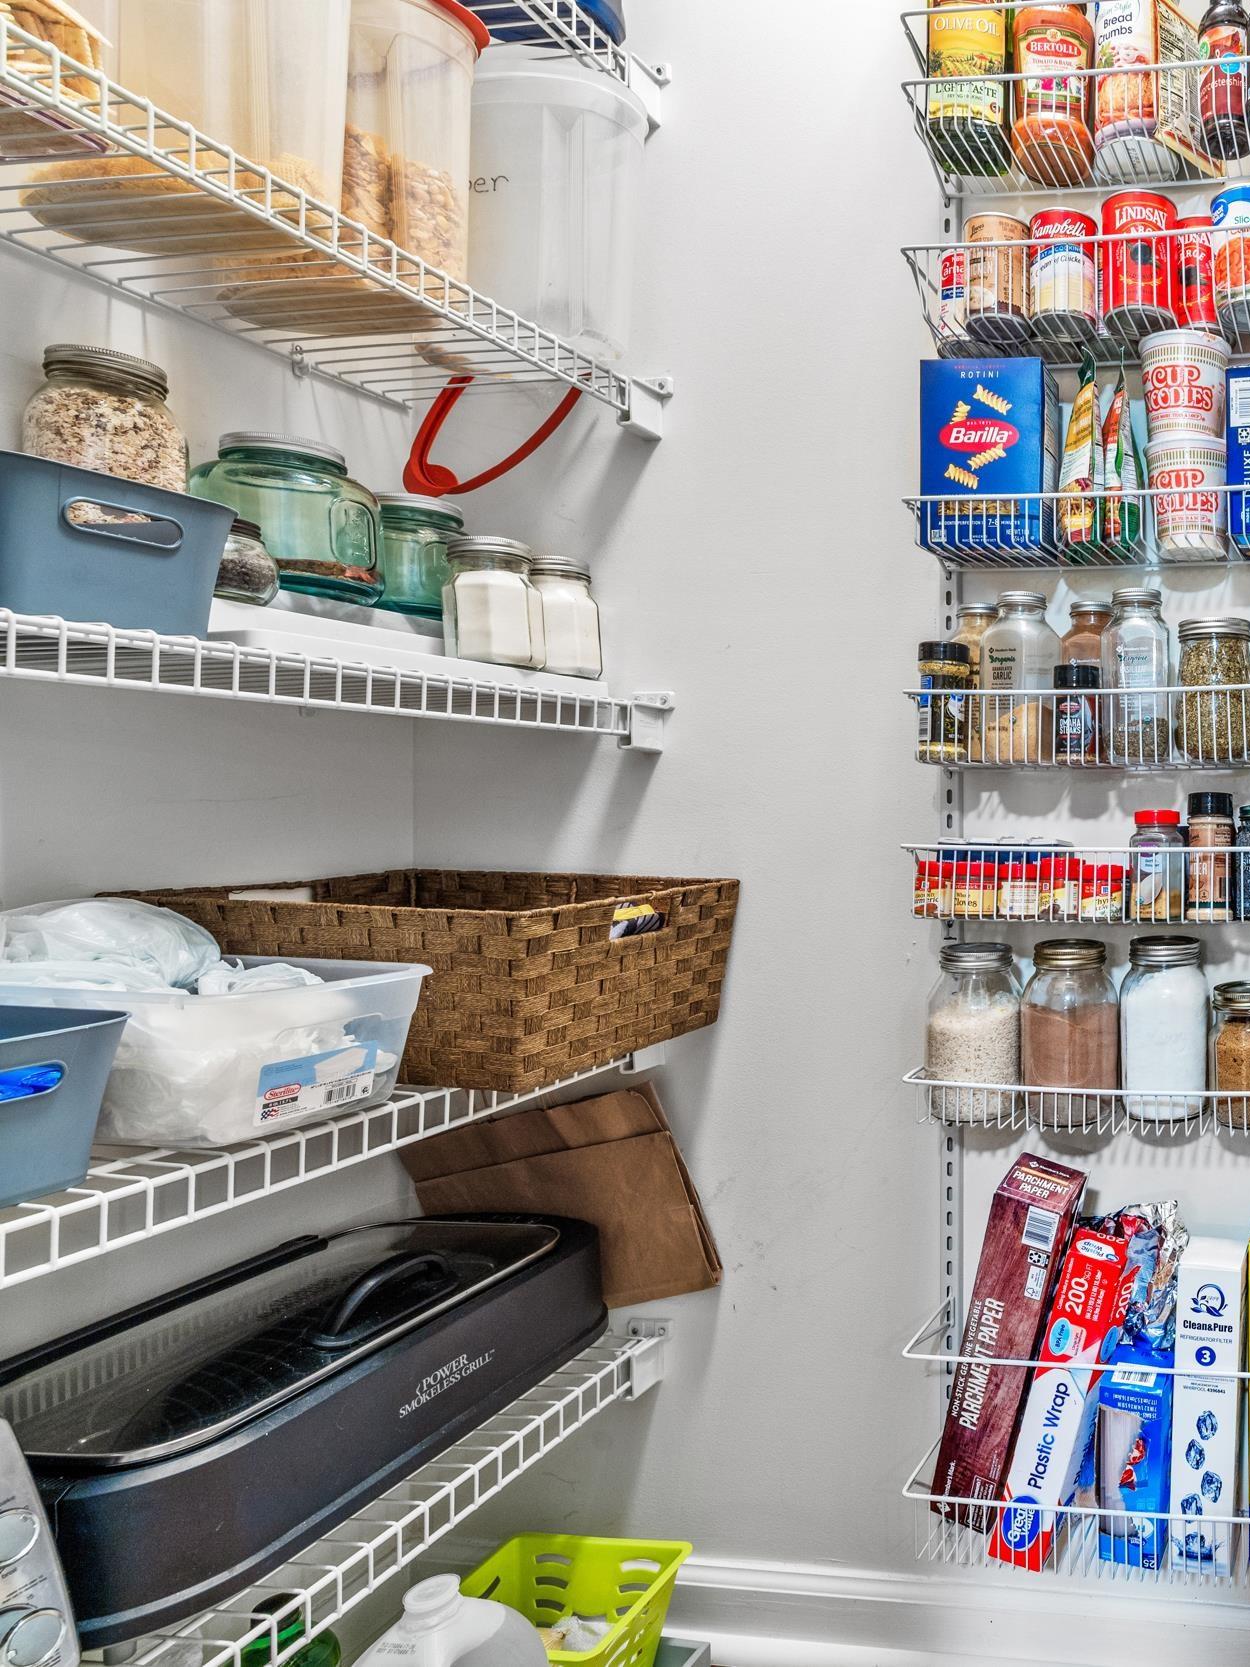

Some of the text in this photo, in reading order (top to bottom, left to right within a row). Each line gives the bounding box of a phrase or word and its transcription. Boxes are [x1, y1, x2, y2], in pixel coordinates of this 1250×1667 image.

[934, 16, 1001, 37] OLIVE OIL
[1103, 12, 1133, 29] Bread
[1097, 26, 1133, 46] Crumbs
[1030, 41, 1078, 56] BERTOLLI
[966, 81, 998, 99] ASTE
[1115, 206, 1168, 231] LINDSAY
[960, 371, 999, 379] ROTINI
[1151, 364, 1201, 389] CUP
[1145, 386, 1213, 413] NOODLES
[949, 426, 1009, 444] Barilla
[992, 671, 1012, 680] GARLIC
[1012, 1170, 1070, 1195] PARCHMENT
[1018, 1182, 1050, 1199] PAPER
[1096, 1233, 1126, 1245] 200
[1065, 1277, 1089, 1316] 200
[1115, 1282, 1134, 1319] 200
[977, 1297, 1005, 1346] PAPER
[1183, 1319, 1233, 1333] Clean&Pure
[1180, 1333, 1217, 1343] REFRIGERATOR
[952, 1299, 982, 1418] NON-STICK GEINE VEGETABLE
[1201, 1349, 1211, 1363] 3
[421, 1354, 469, 1392] POWER
[399, 1371, 461, 1419] SMOKELESS
[1027, 1382, 1070, 1490] Plastic Wrap
[1007, 1507, 1026, 1542] Grea
